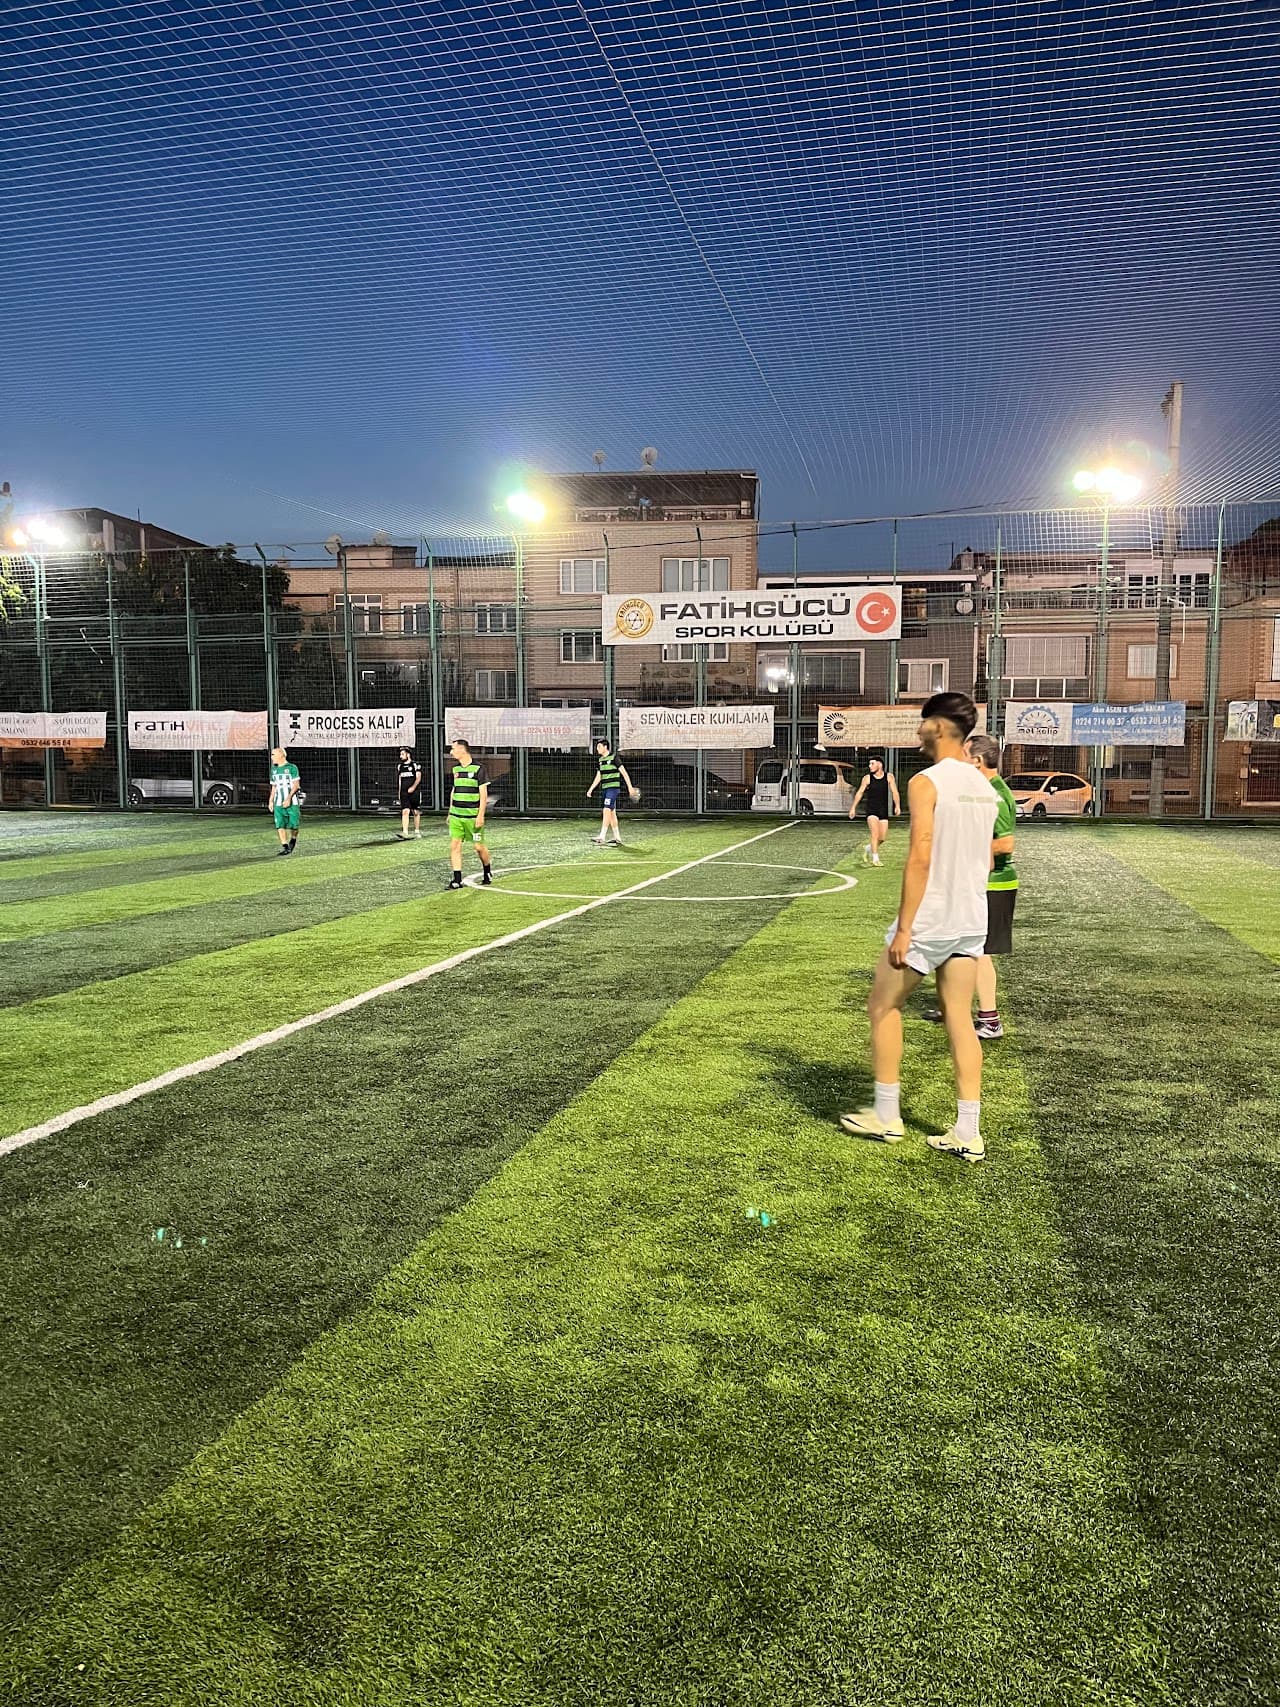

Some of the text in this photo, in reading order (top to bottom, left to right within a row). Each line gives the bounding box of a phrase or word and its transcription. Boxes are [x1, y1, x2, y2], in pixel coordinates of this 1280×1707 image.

[660, 592, 850, 621] FATİHGÜCÜ
[676, 620, 833, 638] SPOR KULÜBÜ
[308, 715, 404, 730] PROCESS KALIP
[640, 711, 769, 727] SEVİNÇLER KUMLAMA
[1075, 717, 1091, 726] 0224
[1094, 717, 1105, 726] 214
